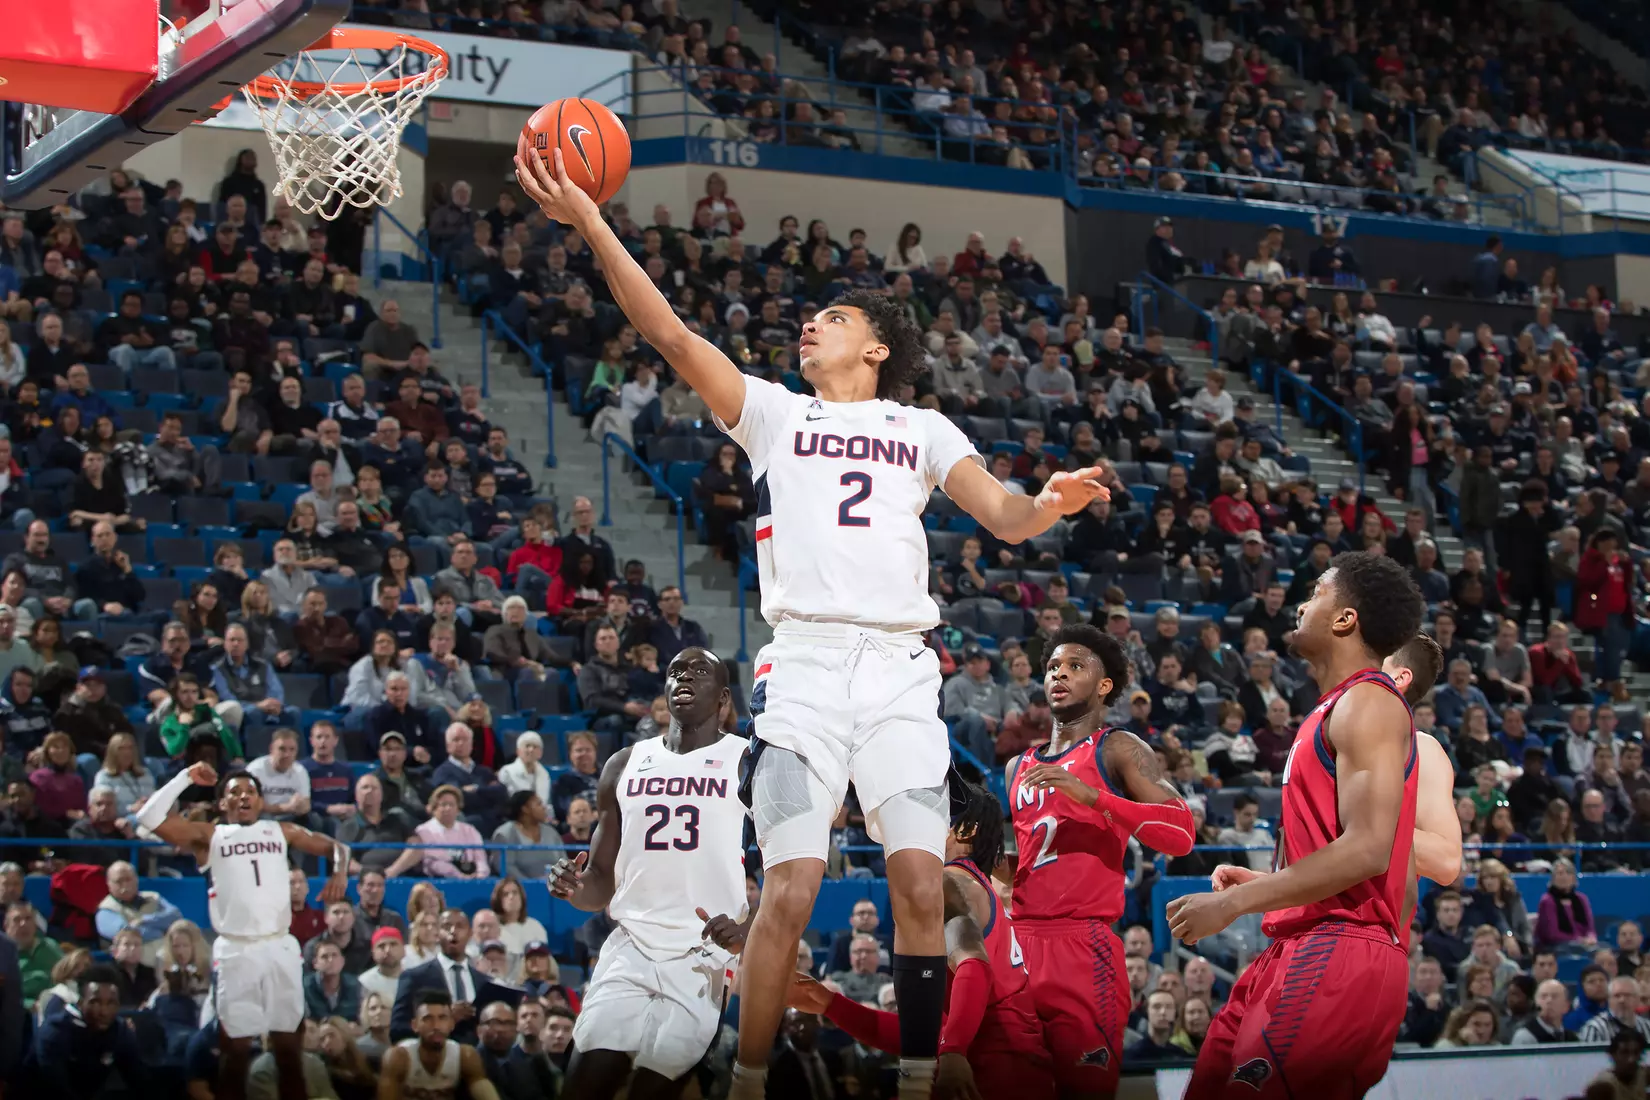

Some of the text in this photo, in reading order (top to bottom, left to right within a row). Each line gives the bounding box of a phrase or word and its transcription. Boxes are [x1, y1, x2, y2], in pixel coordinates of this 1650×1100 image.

[373, 34, 512, 96] xity
[708, 140, 760, 167] 116
[794, 431, 918, 472] UCONN
[838, 471, 873, 527] 2
[626, 776, 728, 798] UCONN
[644, 804, 700, 851] 23
[1032, 815, 1058, 871] 2
[221, 842, 282, 857] UCONN
[250, 860, 261, 886] 1
